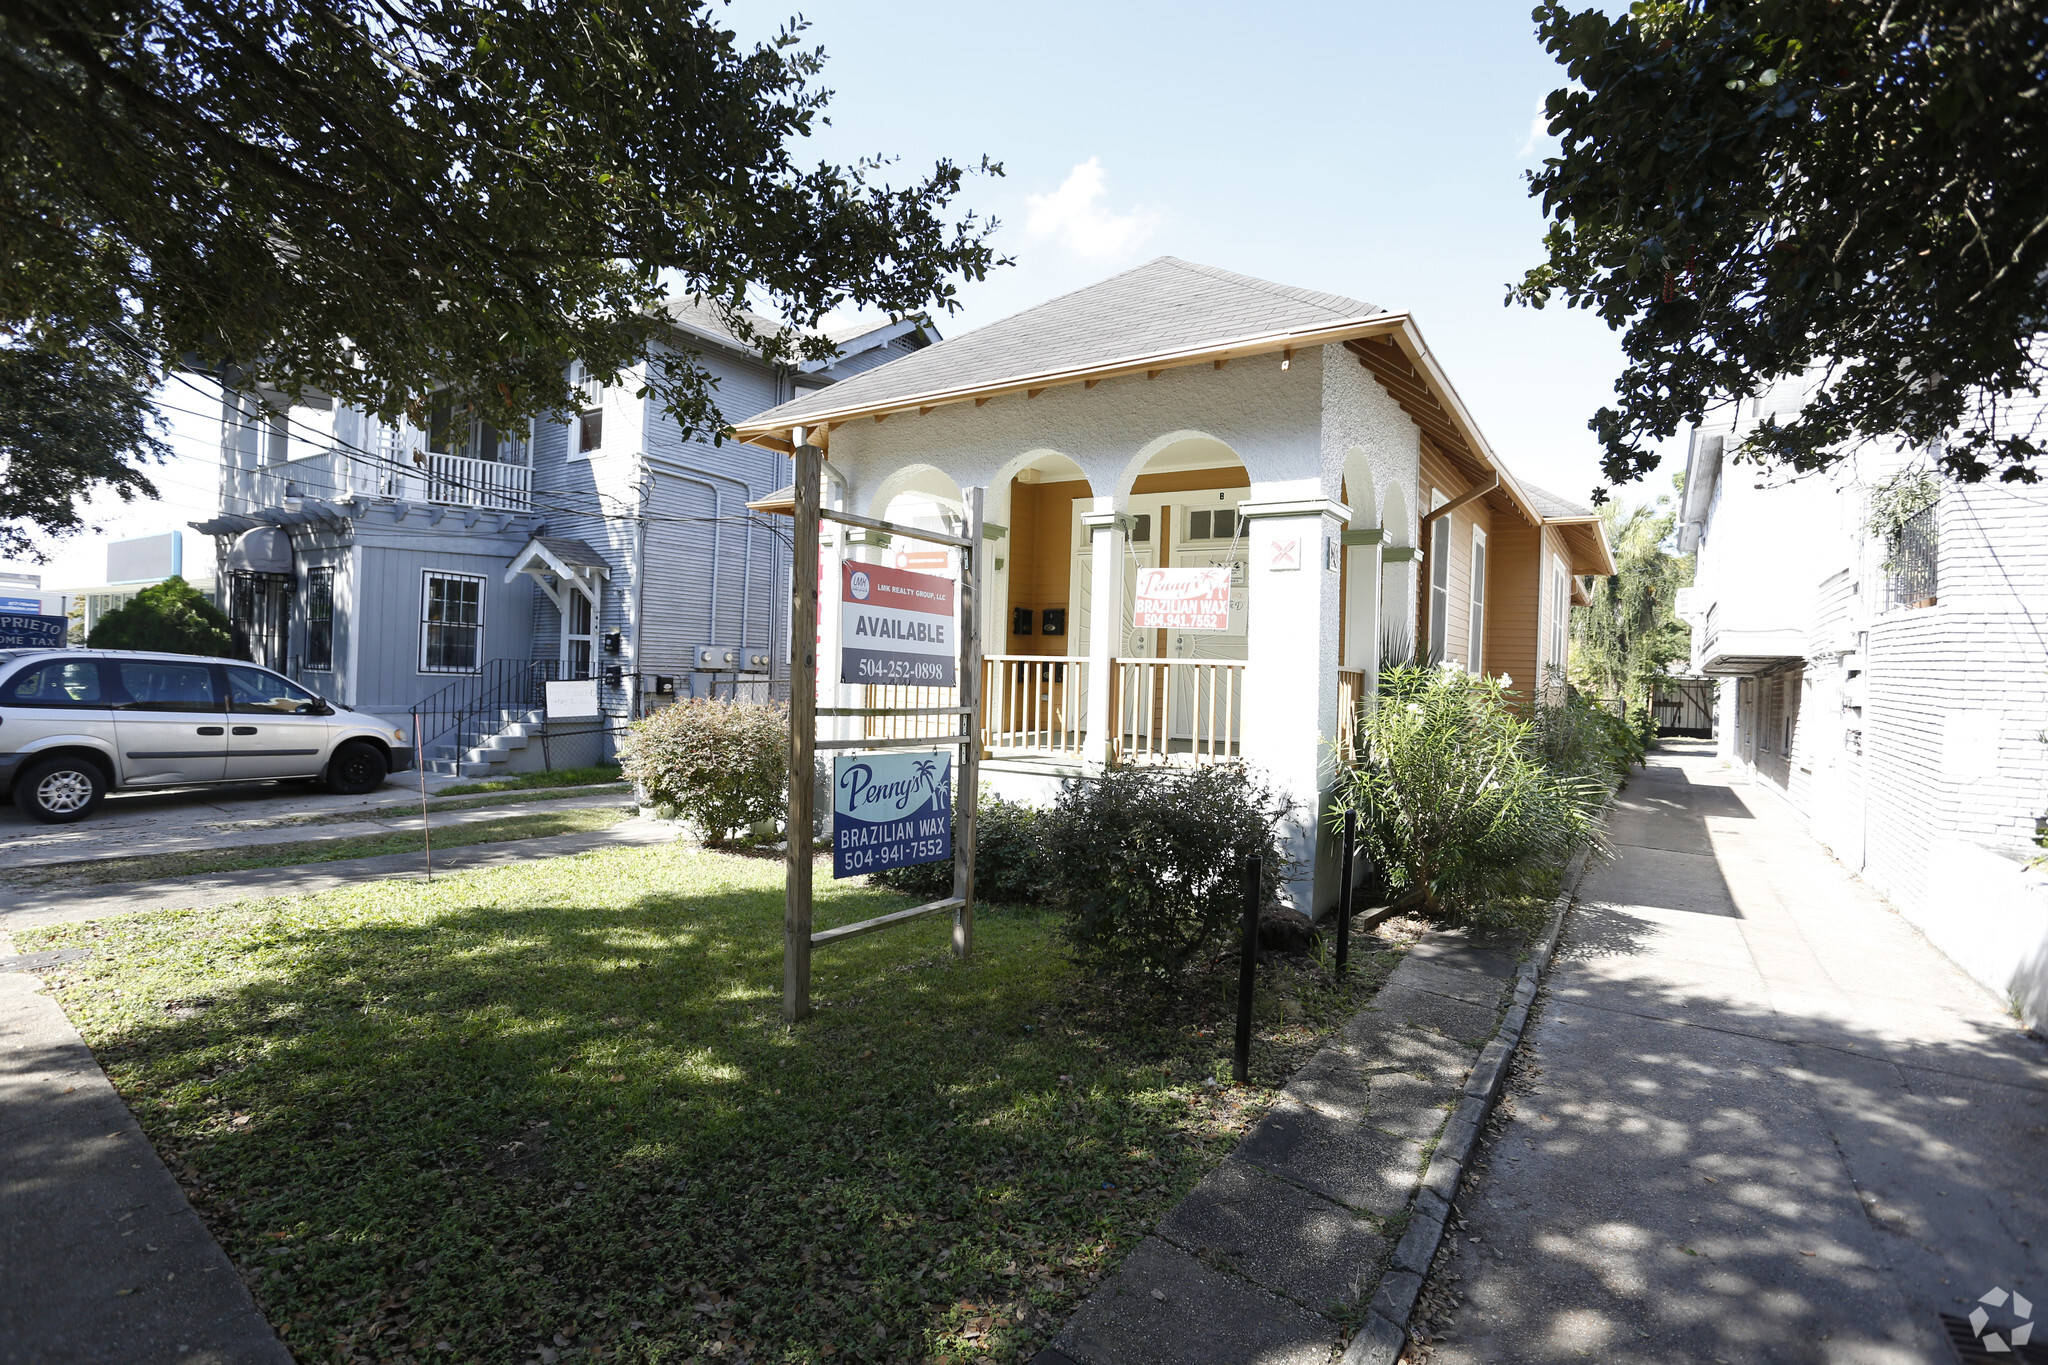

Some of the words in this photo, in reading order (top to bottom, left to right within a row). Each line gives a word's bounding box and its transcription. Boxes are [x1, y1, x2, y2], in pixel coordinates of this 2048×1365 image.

[877, 584, 891, 592] LMK
[891, 585, 915, 597] REALTY
[915, 590, 936, 601] GROUP,
[1136, 599, 1198, 615] BRAZILIAN
[1199, 600, 1228, 615] WAX
[1, 616, 61, 635] PRIETO
[855, 615, 945, 644] AVAILABLE
[1143, 613, 1218, 628] 504.941.7552
[30, 637, 55, 646] TAX
[858, 658, 943, 680] 504-252-0898
[840, 763, 920, 812] Penny's
[841, 821, 914, 849] BRAZILIAN
[919, 816, 945, 837] WAX
[844, 838, 943, 871] 504-941-7552
